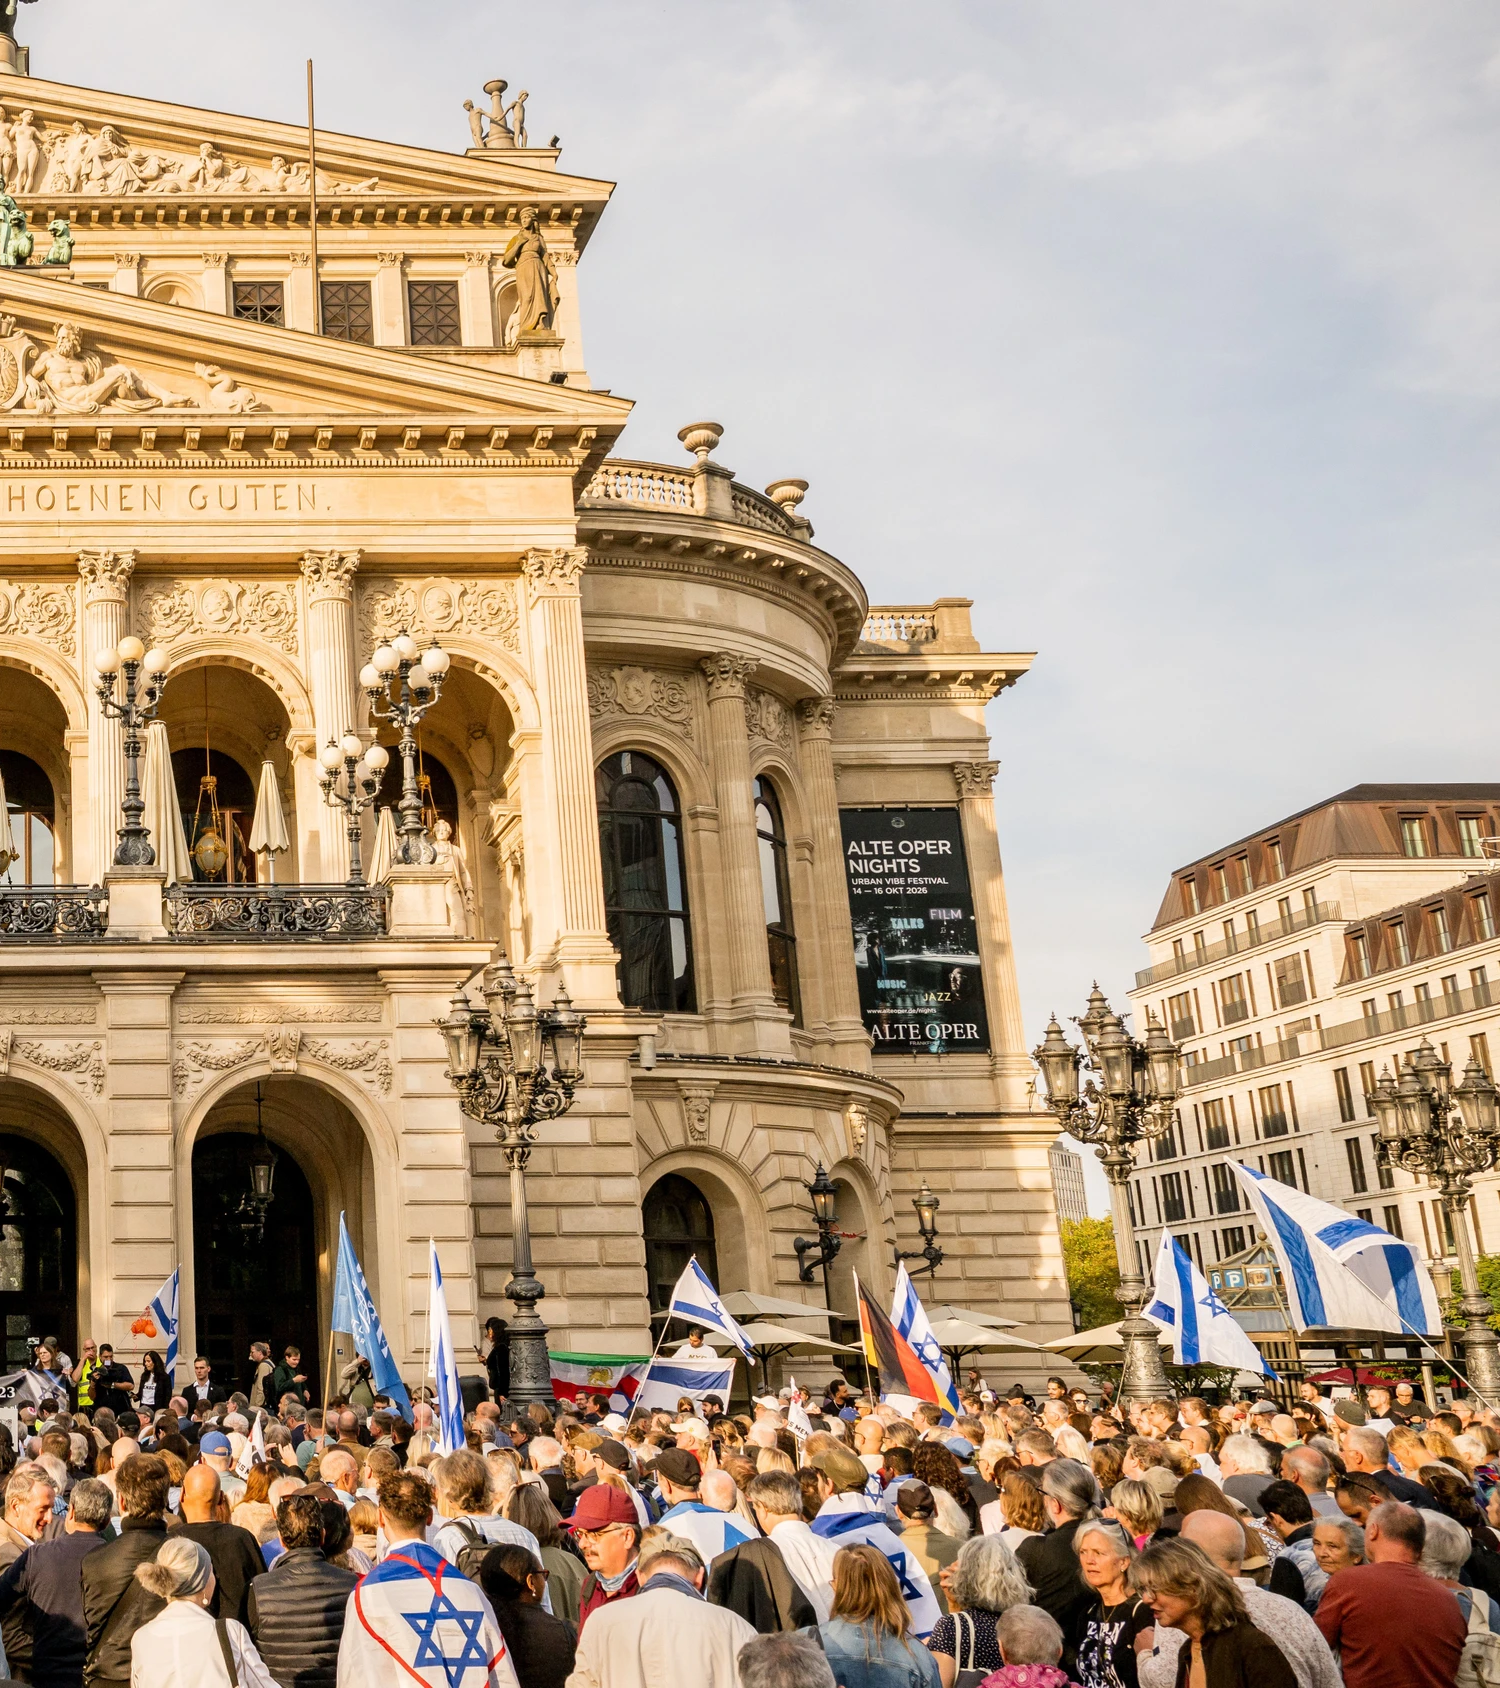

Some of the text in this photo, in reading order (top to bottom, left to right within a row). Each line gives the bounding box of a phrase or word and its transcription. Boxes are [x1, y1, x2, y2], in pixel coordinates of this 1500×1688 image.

[189, 483, 332, 512] GUTEN.
[847, 840, 952, 855] ALTE OPER
[849, 858, 921, 874] NIGHTS
[884, 877, 906, 885] VIBE
[907, 877, 949, 885] FESTIVAL
[906, 886, 928, 894] 2026
[929, 908, 963, 920] FILM
[889, 917, 925, 929] TALKS
[876, 979, 907, 989] MUSIC
[923, 992, 952, 1002] JAZZ
[871, 1023, 980, 1040] ALTE OPER
